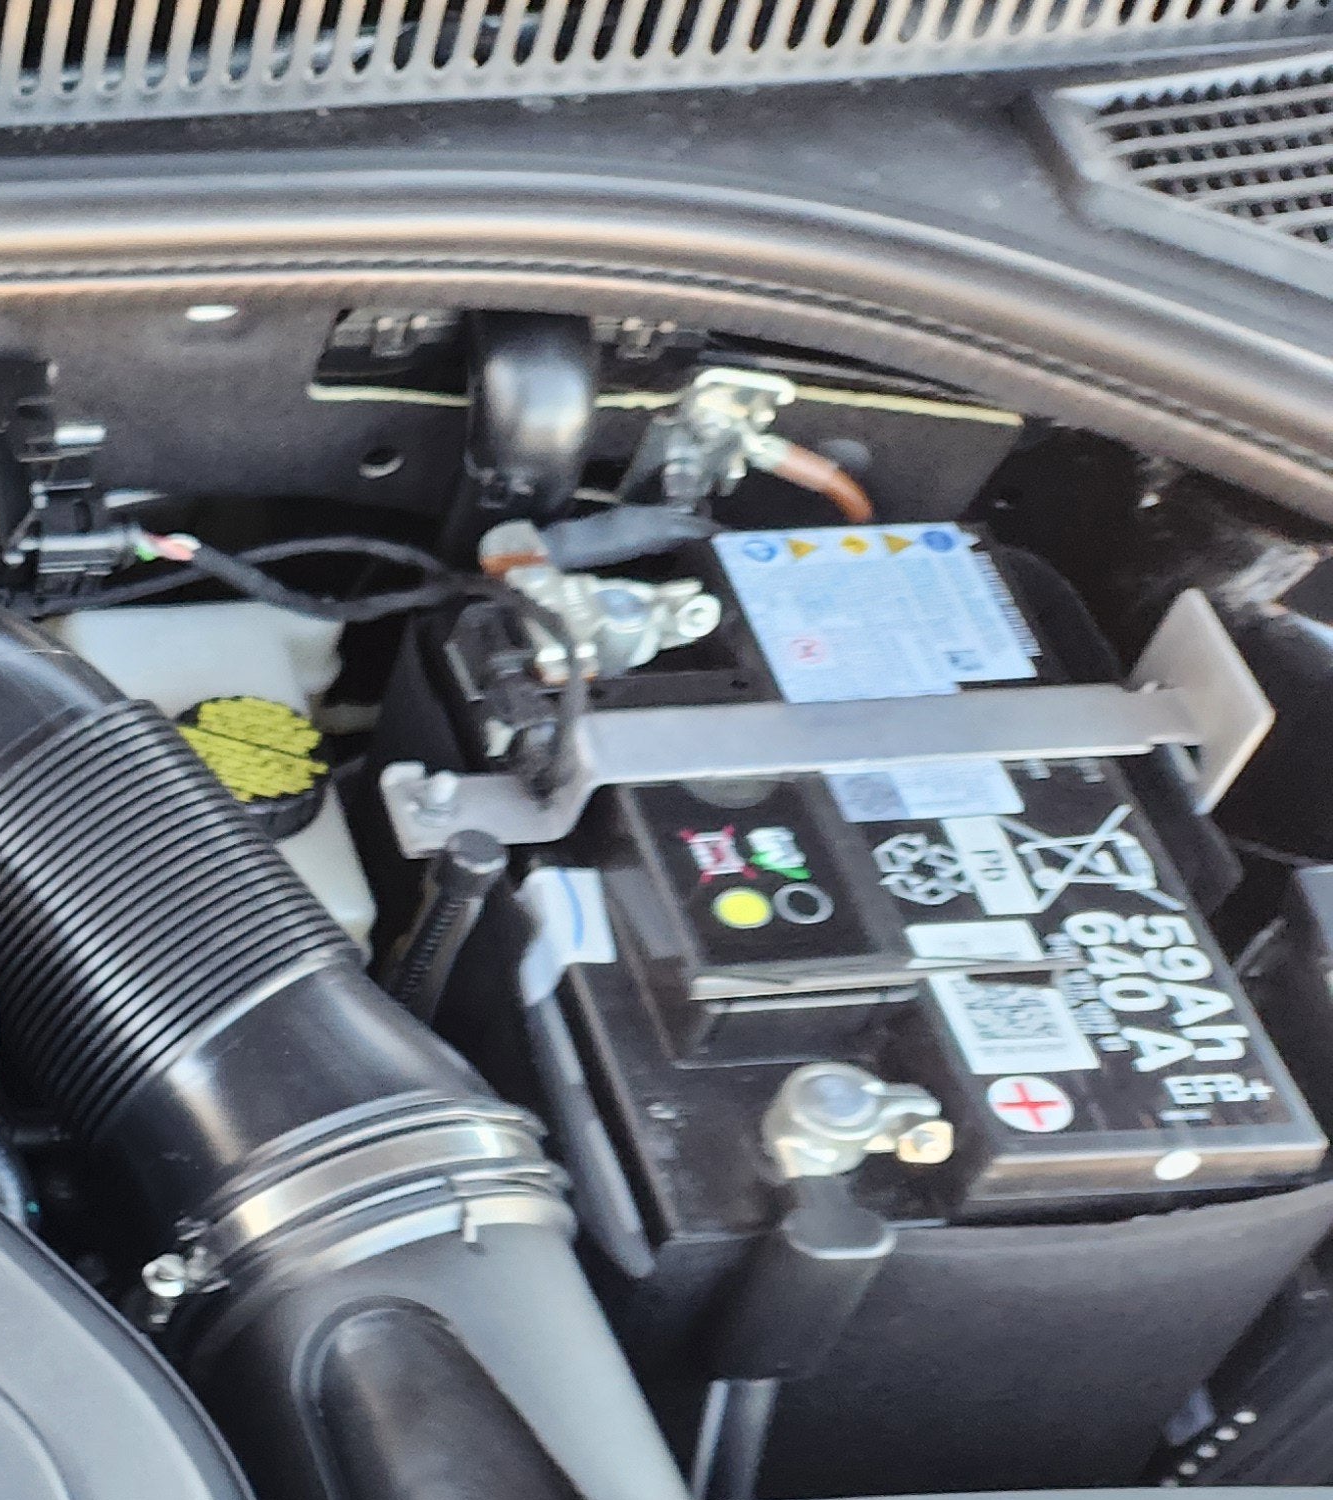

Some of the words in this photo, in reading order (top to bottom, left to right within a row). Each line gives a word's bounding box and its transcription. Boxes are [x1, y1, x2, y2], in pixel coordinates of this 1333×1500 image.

[1063, 910, 1169, 1012] 640
[1119, 1025, 1196, 1073] A
[1130, 914, 1250, 1062] 59Ah
